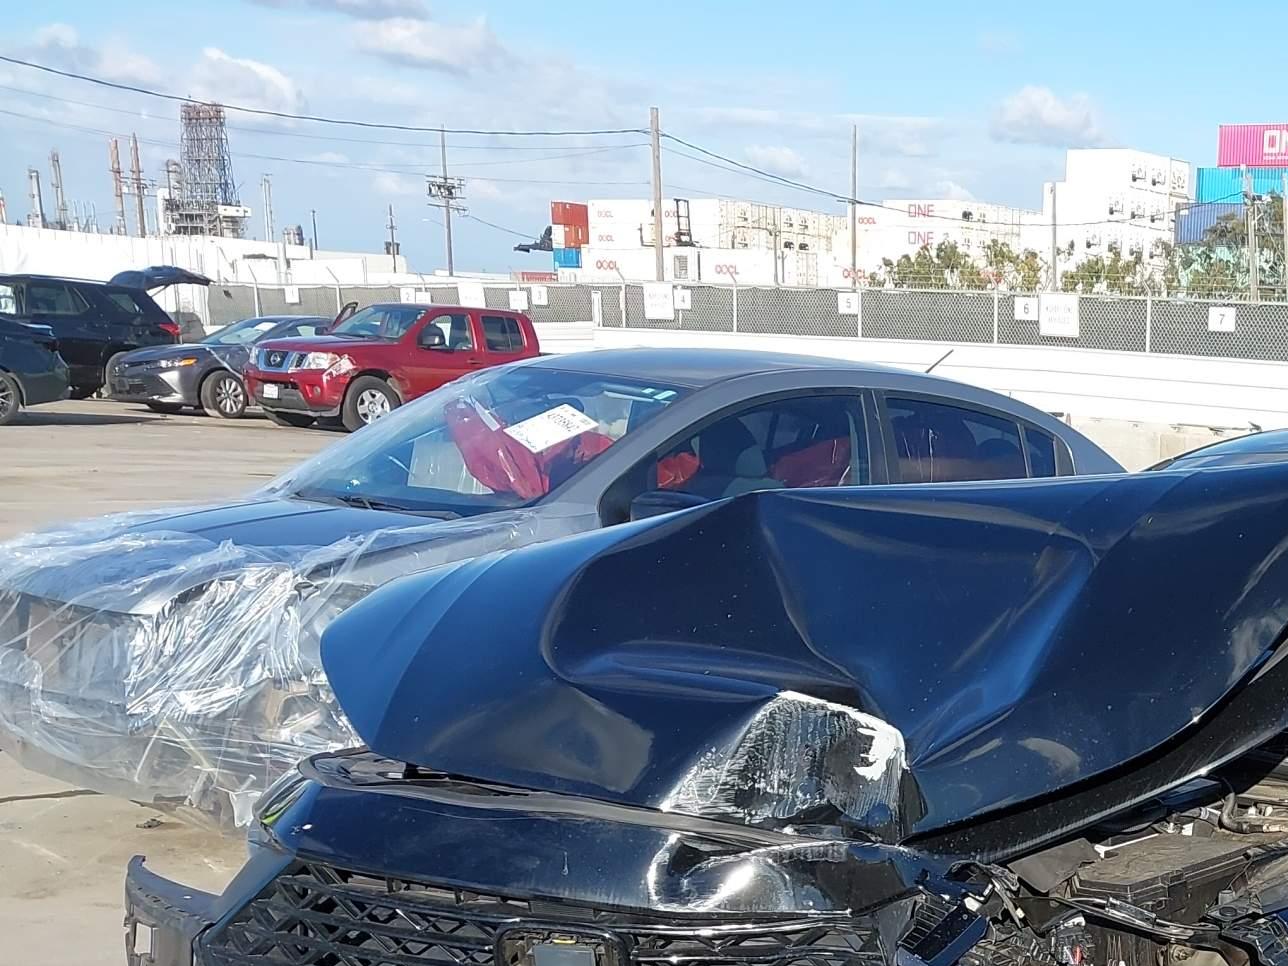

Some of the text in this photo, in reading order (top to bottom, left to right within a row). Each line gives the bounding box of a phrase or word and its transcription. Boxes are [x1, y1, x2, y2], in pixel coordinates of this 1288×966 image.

[907, 203, 935, 219] ONE
[857, 216, 877, 225] OOCL
[907, 231, 934, 245] ONE
[595, 259, 619, 271] OOCL
[714, 264, 740, 275] OOCL
[845, 298, 852, 309] 5
[1023, 303, 1030, 315] 6
[1219, 313, 1226, 325] 7
